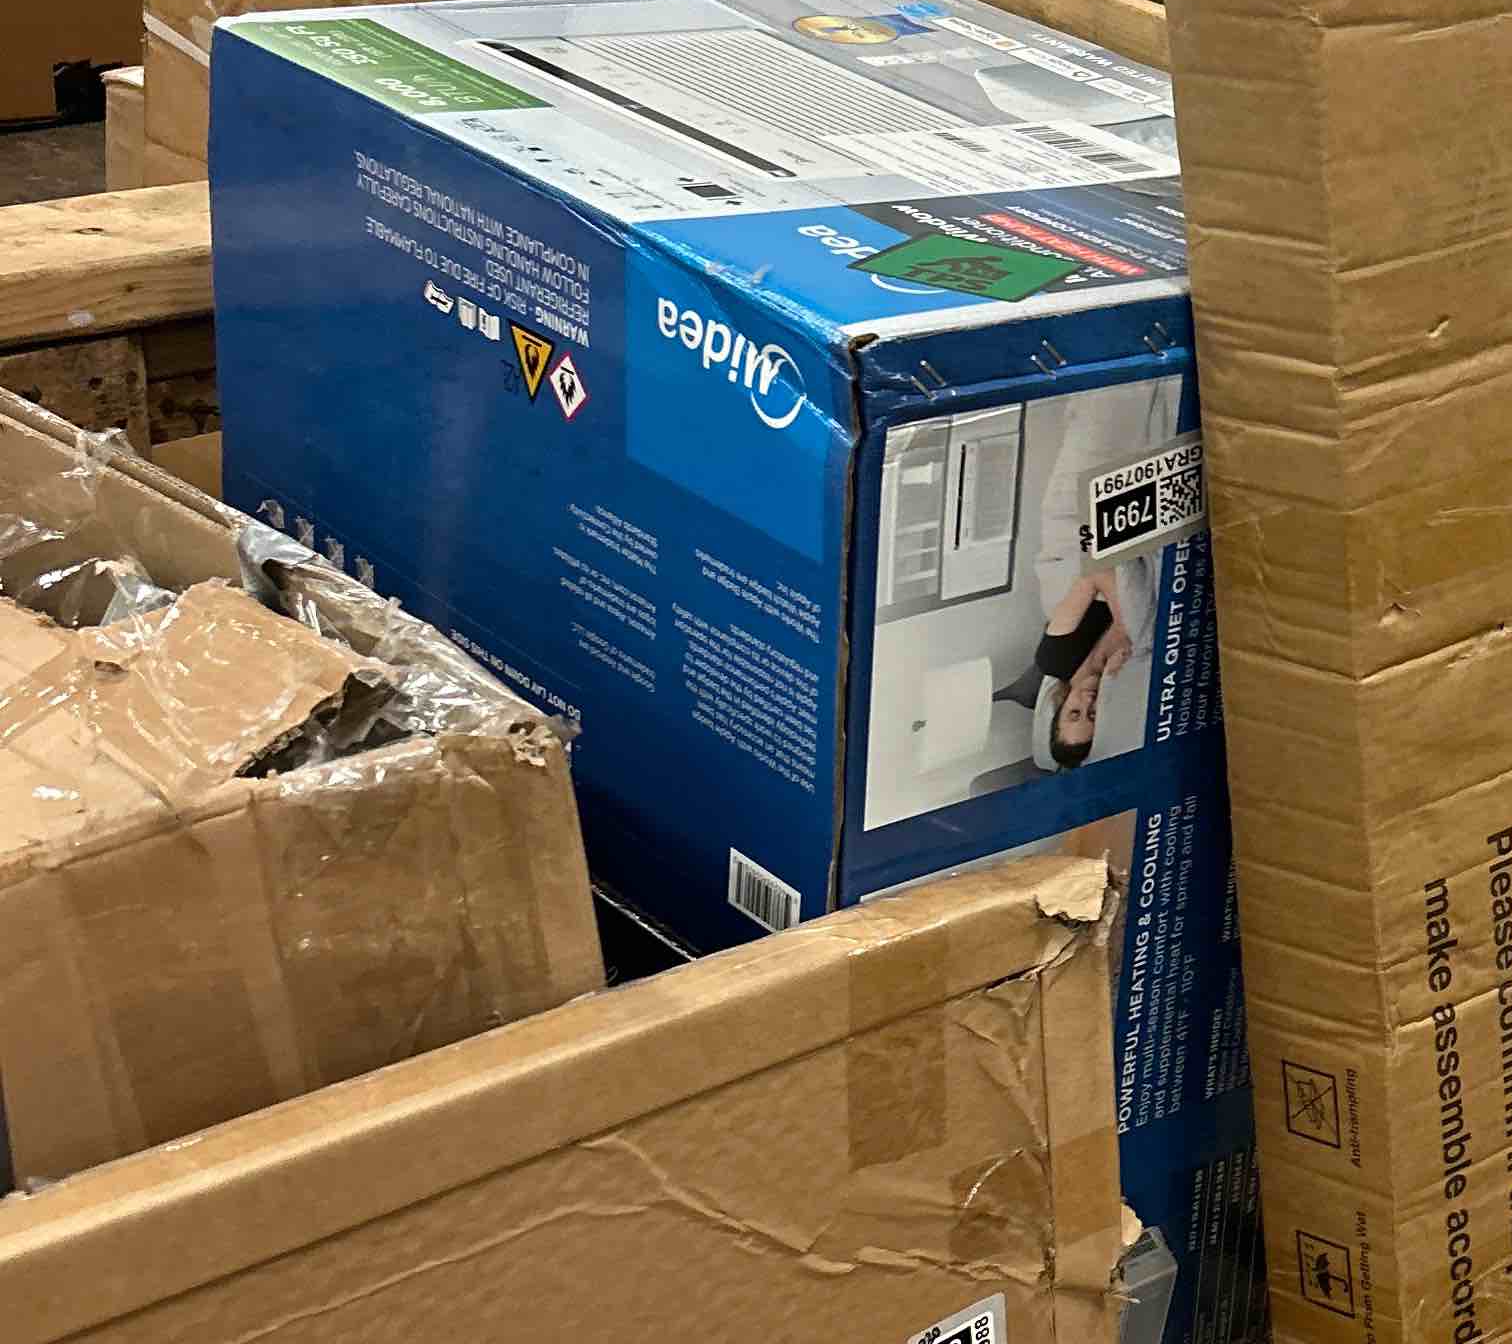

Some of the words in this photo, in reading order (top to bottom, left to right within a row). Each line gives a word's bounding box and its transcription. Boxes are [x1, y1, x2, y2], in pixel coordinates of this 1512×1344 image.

[356, 173, 414, 214] CAREFULLY
[423, 185, 477, 225] NATIONAL
[364, 215, 424, 260] FLAMMABLE
[413, 204, 485, 251] INSTRUCTIONS
[475, 208, 504, 237] WITH
[423, 247, 439, 269] TO
[440, 256, 463, 279] DUE
[485, 237, 540, 278] HANDLING
[506, 224, 577, 275] COMPLIANCE
[463, 267, 487, 294] FIRE
[485, 283, 502, 302] OF
[486, 258, 514, 288] USED
[539, 267, 590, 303] FOLLOW
[577, 262, 590, 282] IN
[904, 268, 990, 293] TPS
[502, 293, 528, 317] RISK
[514, 275, 590, 325] REFRIGERANT
[535, 306, 590, 348] WARNING
[658, 297, 804, 424] Midea
[1094, 444, 1203, 501] GRA1907991
[1101, 494, 1154, 538] 7991
[1188, 582, 1202, 615] low
[1164, 601, 1184, 666] QUIET
[504, 663, 531, 689] DOWN
[1180, 640, 1195, 686] level
[547, 692, 567, 712] NOT
[567, 705, 581, 721] DO
[1156, 670, 1178, 743] ULTRA
[1174, 688, 1192, 738] Noise
[1184, 794, 1200, 822] fall
[1164, 804, 1183, 868] cooling
[1181, 823, 1196, 857] and
[1139, 812, 1163, 908] COOLING
[1160, 873, 1172, 908] with
[1175, 857, 1193, 911] spring
[1138, 912, 1152, 927] &
[1153, 909, 1169, 971] comfort
[1173, 912, 1185, 940] for
[1424, 878, 1458, 994] make
[1128, 931, 1150, 1023] HEATING
[1168, 939, 1182, 976] heat
[1143, 972, 1163, 1077] multi-season
[1157, 978, 1179, 1089] supplemental
[1117, 1025, 1141, 1136] POWERFUL
[1168, 1049, 1187, 1116] between
[1135, 1076, 1154, 1127] Enjoy
[1153, 1090, 1165, 1120] and
[1432, 1001, 1473, 1202] assemble
[1360, 1241, 1373, 1296] Getting
[1363, 1297, 1374, 1330] From
